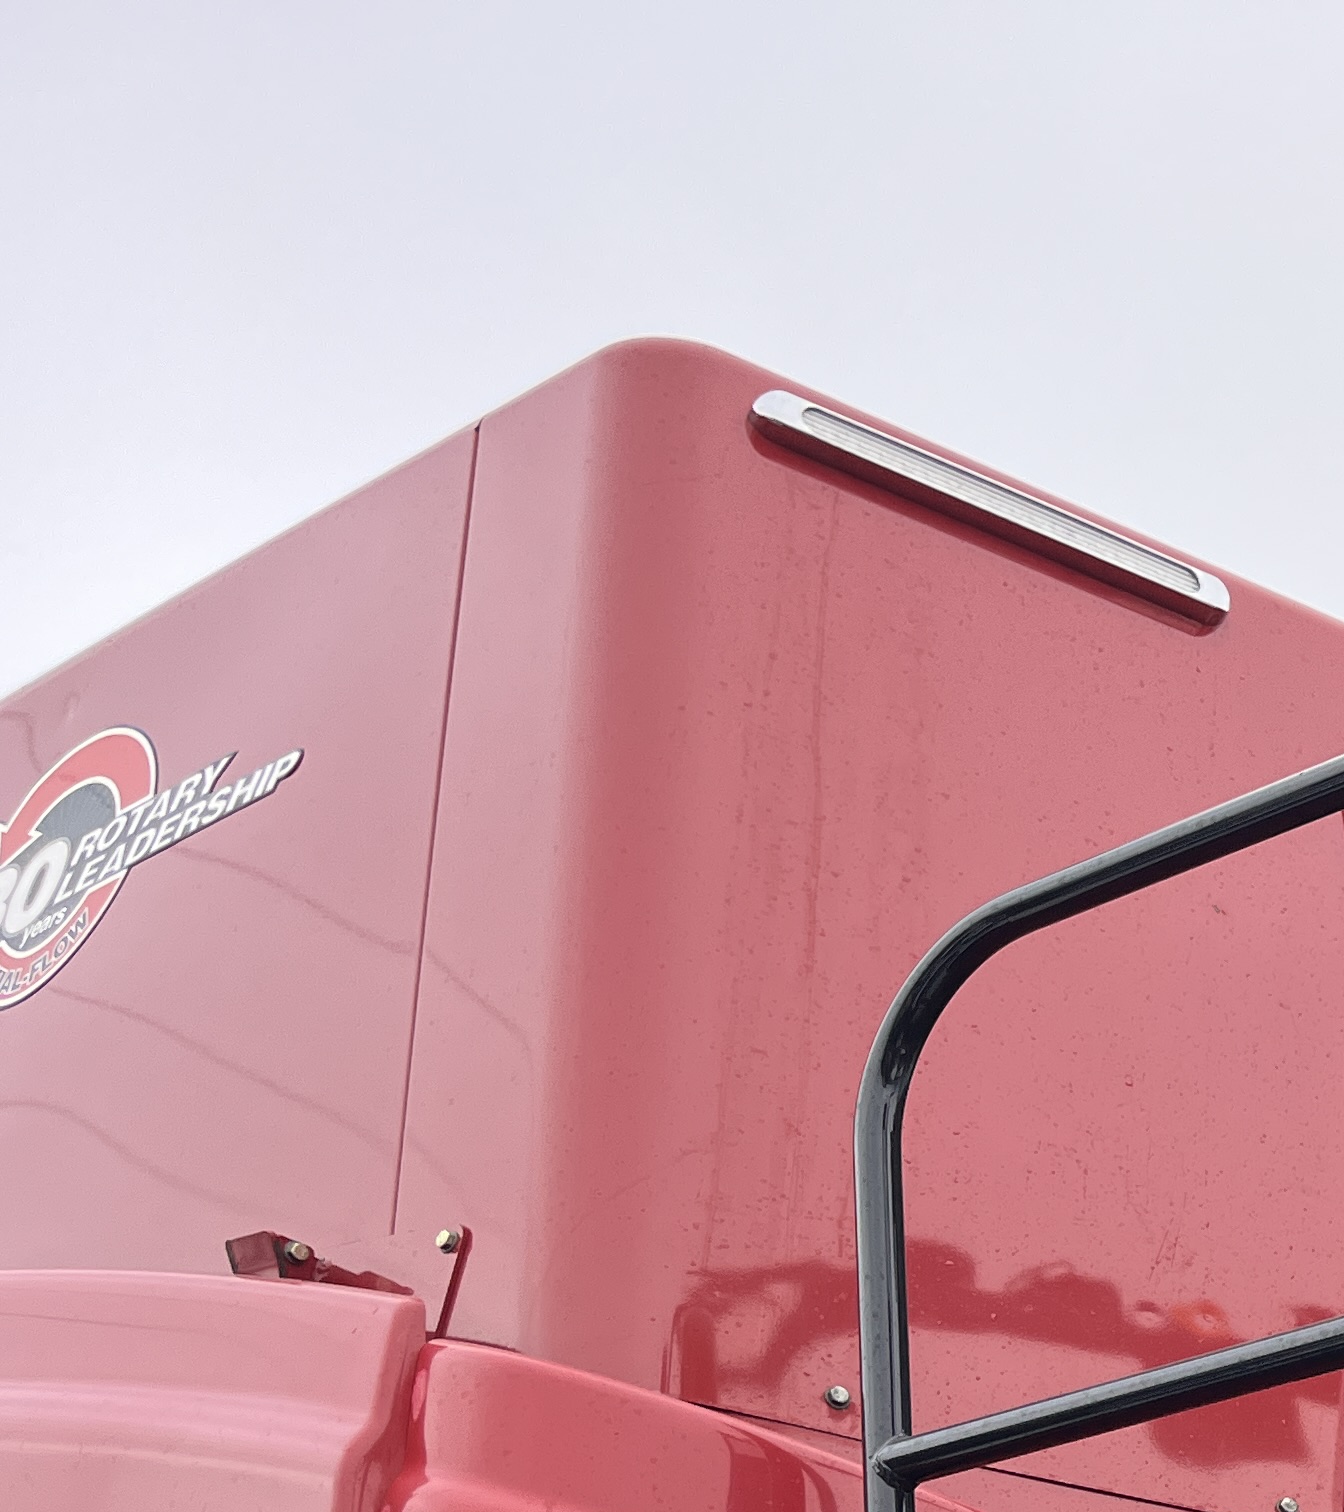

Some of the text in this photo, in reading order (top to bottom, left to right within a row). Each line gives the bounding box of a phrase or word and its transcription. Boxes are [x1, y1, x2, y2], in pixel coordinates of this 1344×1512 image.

[53, 750, 301, 906] LEADERSHIP
[70, 756, 230, 867] ROTARY
[18, 906, 68, 950] years
